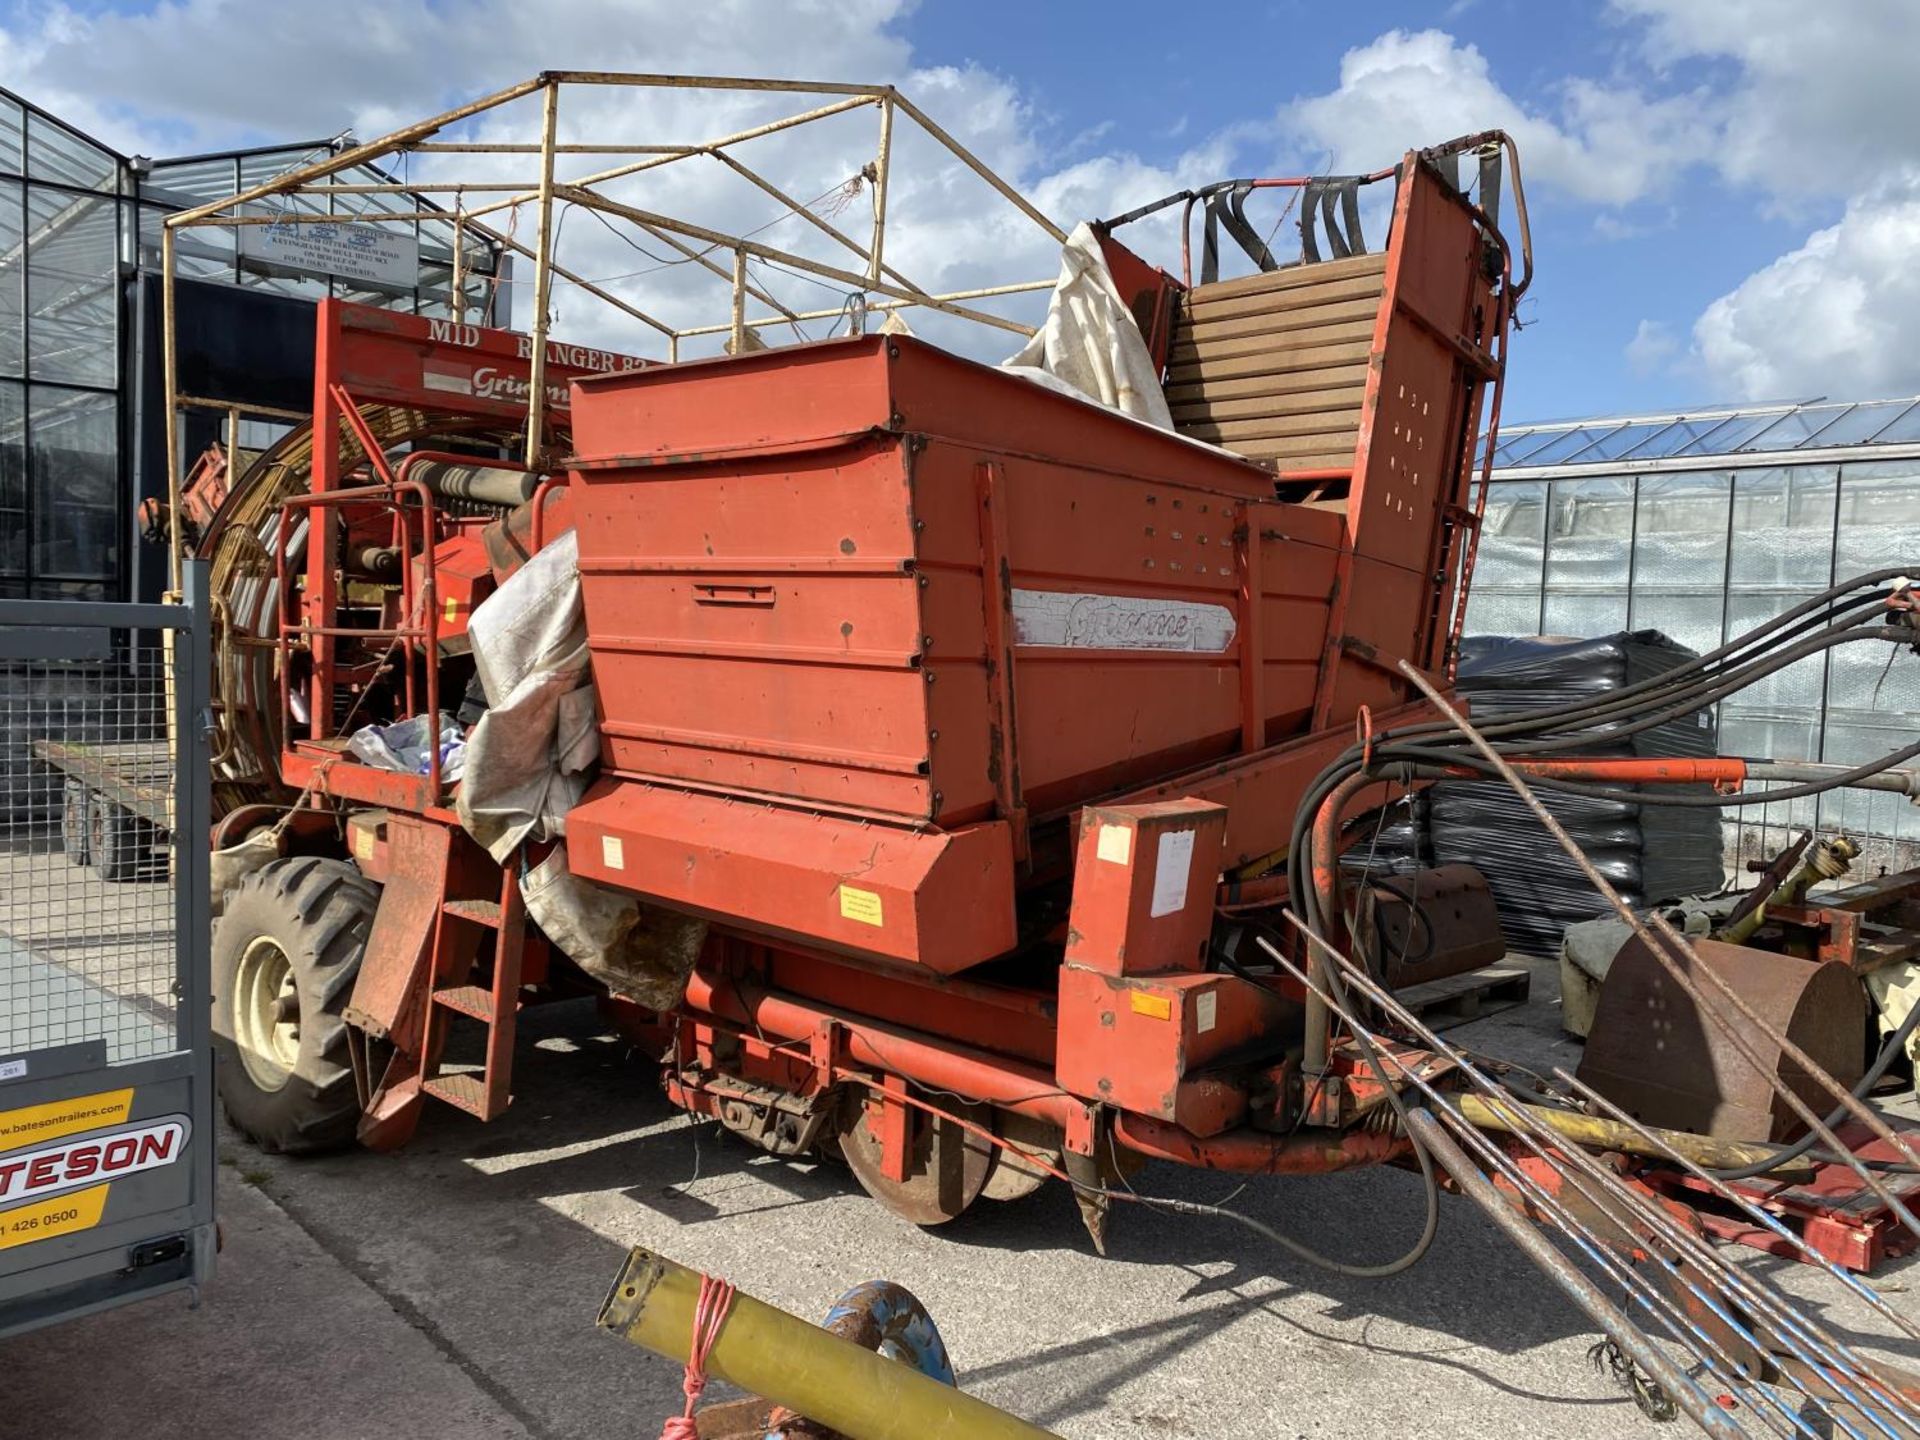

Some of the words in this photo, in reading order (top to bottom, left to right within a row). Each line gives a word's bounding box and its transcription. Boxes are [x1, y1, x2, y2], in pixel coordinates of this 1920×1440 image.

[304, 250, 315, 258] ON
[317, 253, 346, 264] BEHALF
[332, 248, 354, 258] HULL
[284, 254, 304, 264] FOUR
[307, 259, 327, 268] OAKS
[334, 264, 377, 277] NURSERIES
[428, 318, 479, 348] MID
[516, 336, 615, 373] RNGER
[12, 1217, 39, 1233] 426
[43, 1208, 79, 1226] 0500
